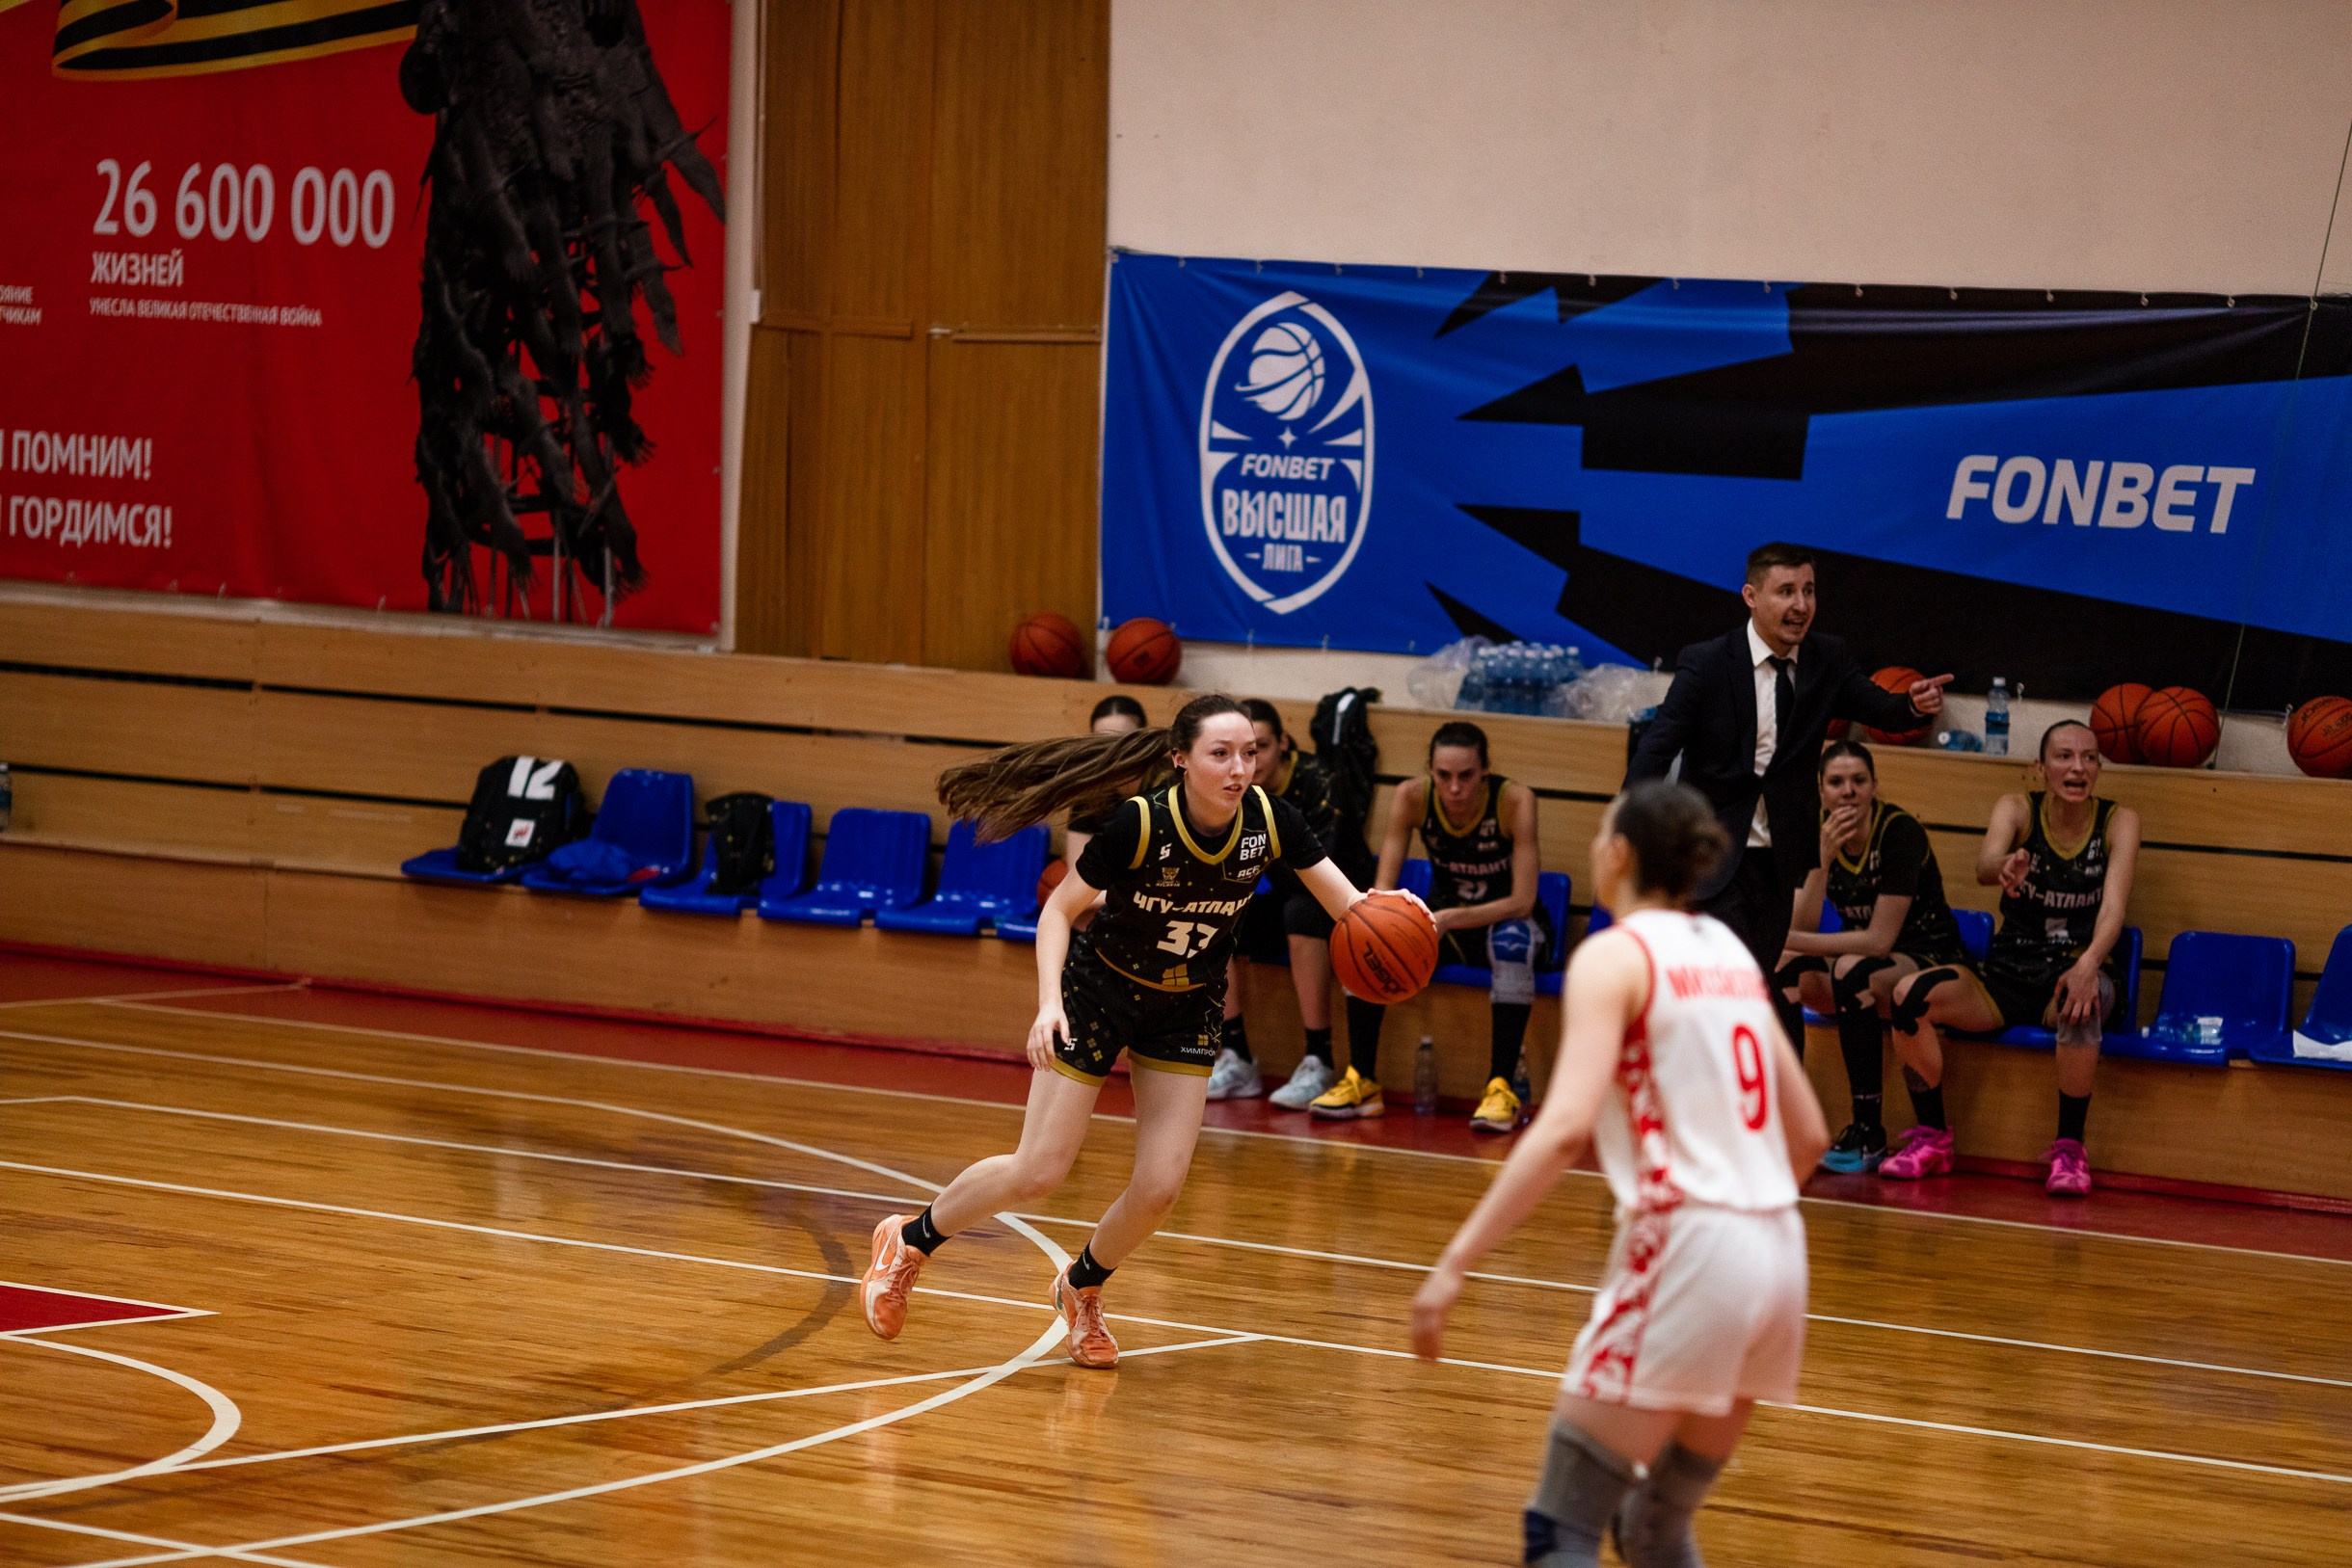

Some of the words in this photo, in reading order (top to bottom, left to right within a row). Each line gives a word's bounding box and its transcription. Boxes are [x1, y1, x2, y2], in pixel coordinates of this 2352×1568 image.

[94, 158, 157, 237] 26
[174, 163, 275, 243] 600
[291, 167, 394, 248] 000
[91, 249, 184, 287] ЖИЗНЕЙ
[90, 297, 136, 317] УНЕСЛА
[137, 299, 188, 320] ВЕЛИКАЯ
[189, 301, 279, 325] ОТЕЧЕСТВЕННАЯ
[280, 304, 322, 327] ВОЙНА
[12, 430, 152, 480] ПОМНИМ!
[1241, 453, 1335, 481] FONBET
[1946, 455, 2256, 534] FONBET
[9, 495, 173, 548] ГОРДИМСЯ!
[1222, 489, 1347, 543] ВЫСШАЯ
[1263, 543, 1303, 571] ЛИГА
[507, 755, 564, 800] 12
[1240, 845, 1266, 861] BET
[1241, 833, 1267, 849] FON
[1133, 890, 1254, 917] ЧГУ-АТЛАН
[1731, 1023, 1768, 1132] 9
